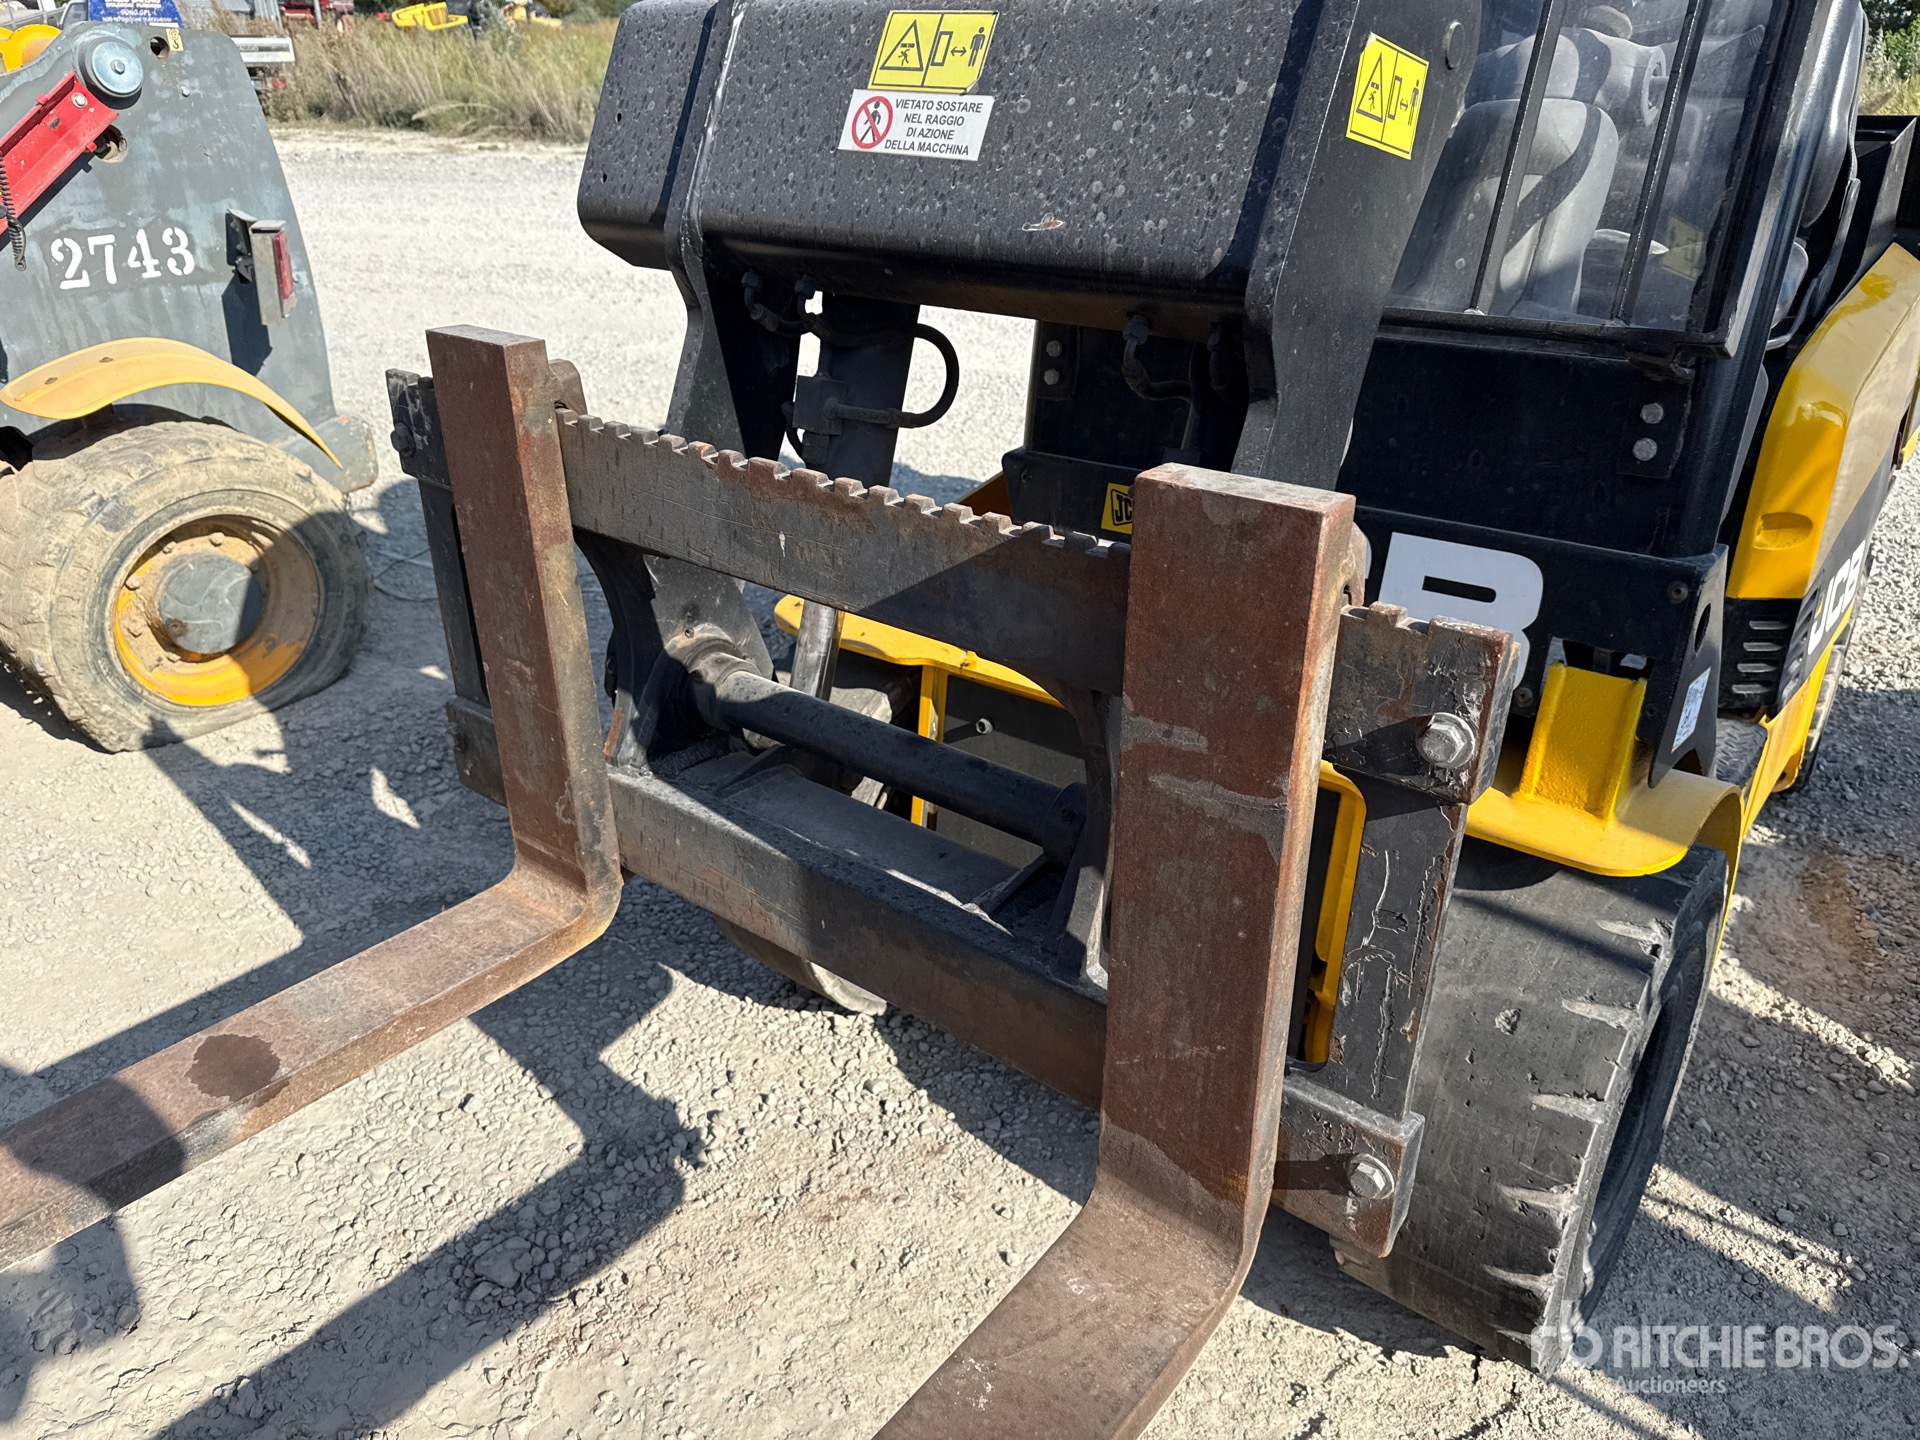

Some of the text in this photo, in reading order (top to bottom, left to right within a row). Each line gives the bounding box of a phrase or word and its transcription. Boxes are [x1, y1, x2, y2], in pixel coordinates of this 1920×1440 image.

[895, 98, 983, 113] VIETATO SOSTARE
[904, 113, 965, 126] NEL RAGGIO
[906, 127, 955, 140] DI AZIONE
[884, 139, 969, 155] DELLA MACCHINA
[51, 227, 195, 289] 2743
[1114, 493, 1133, 522] JC
[1807, 539, 1866, 656] JCB
